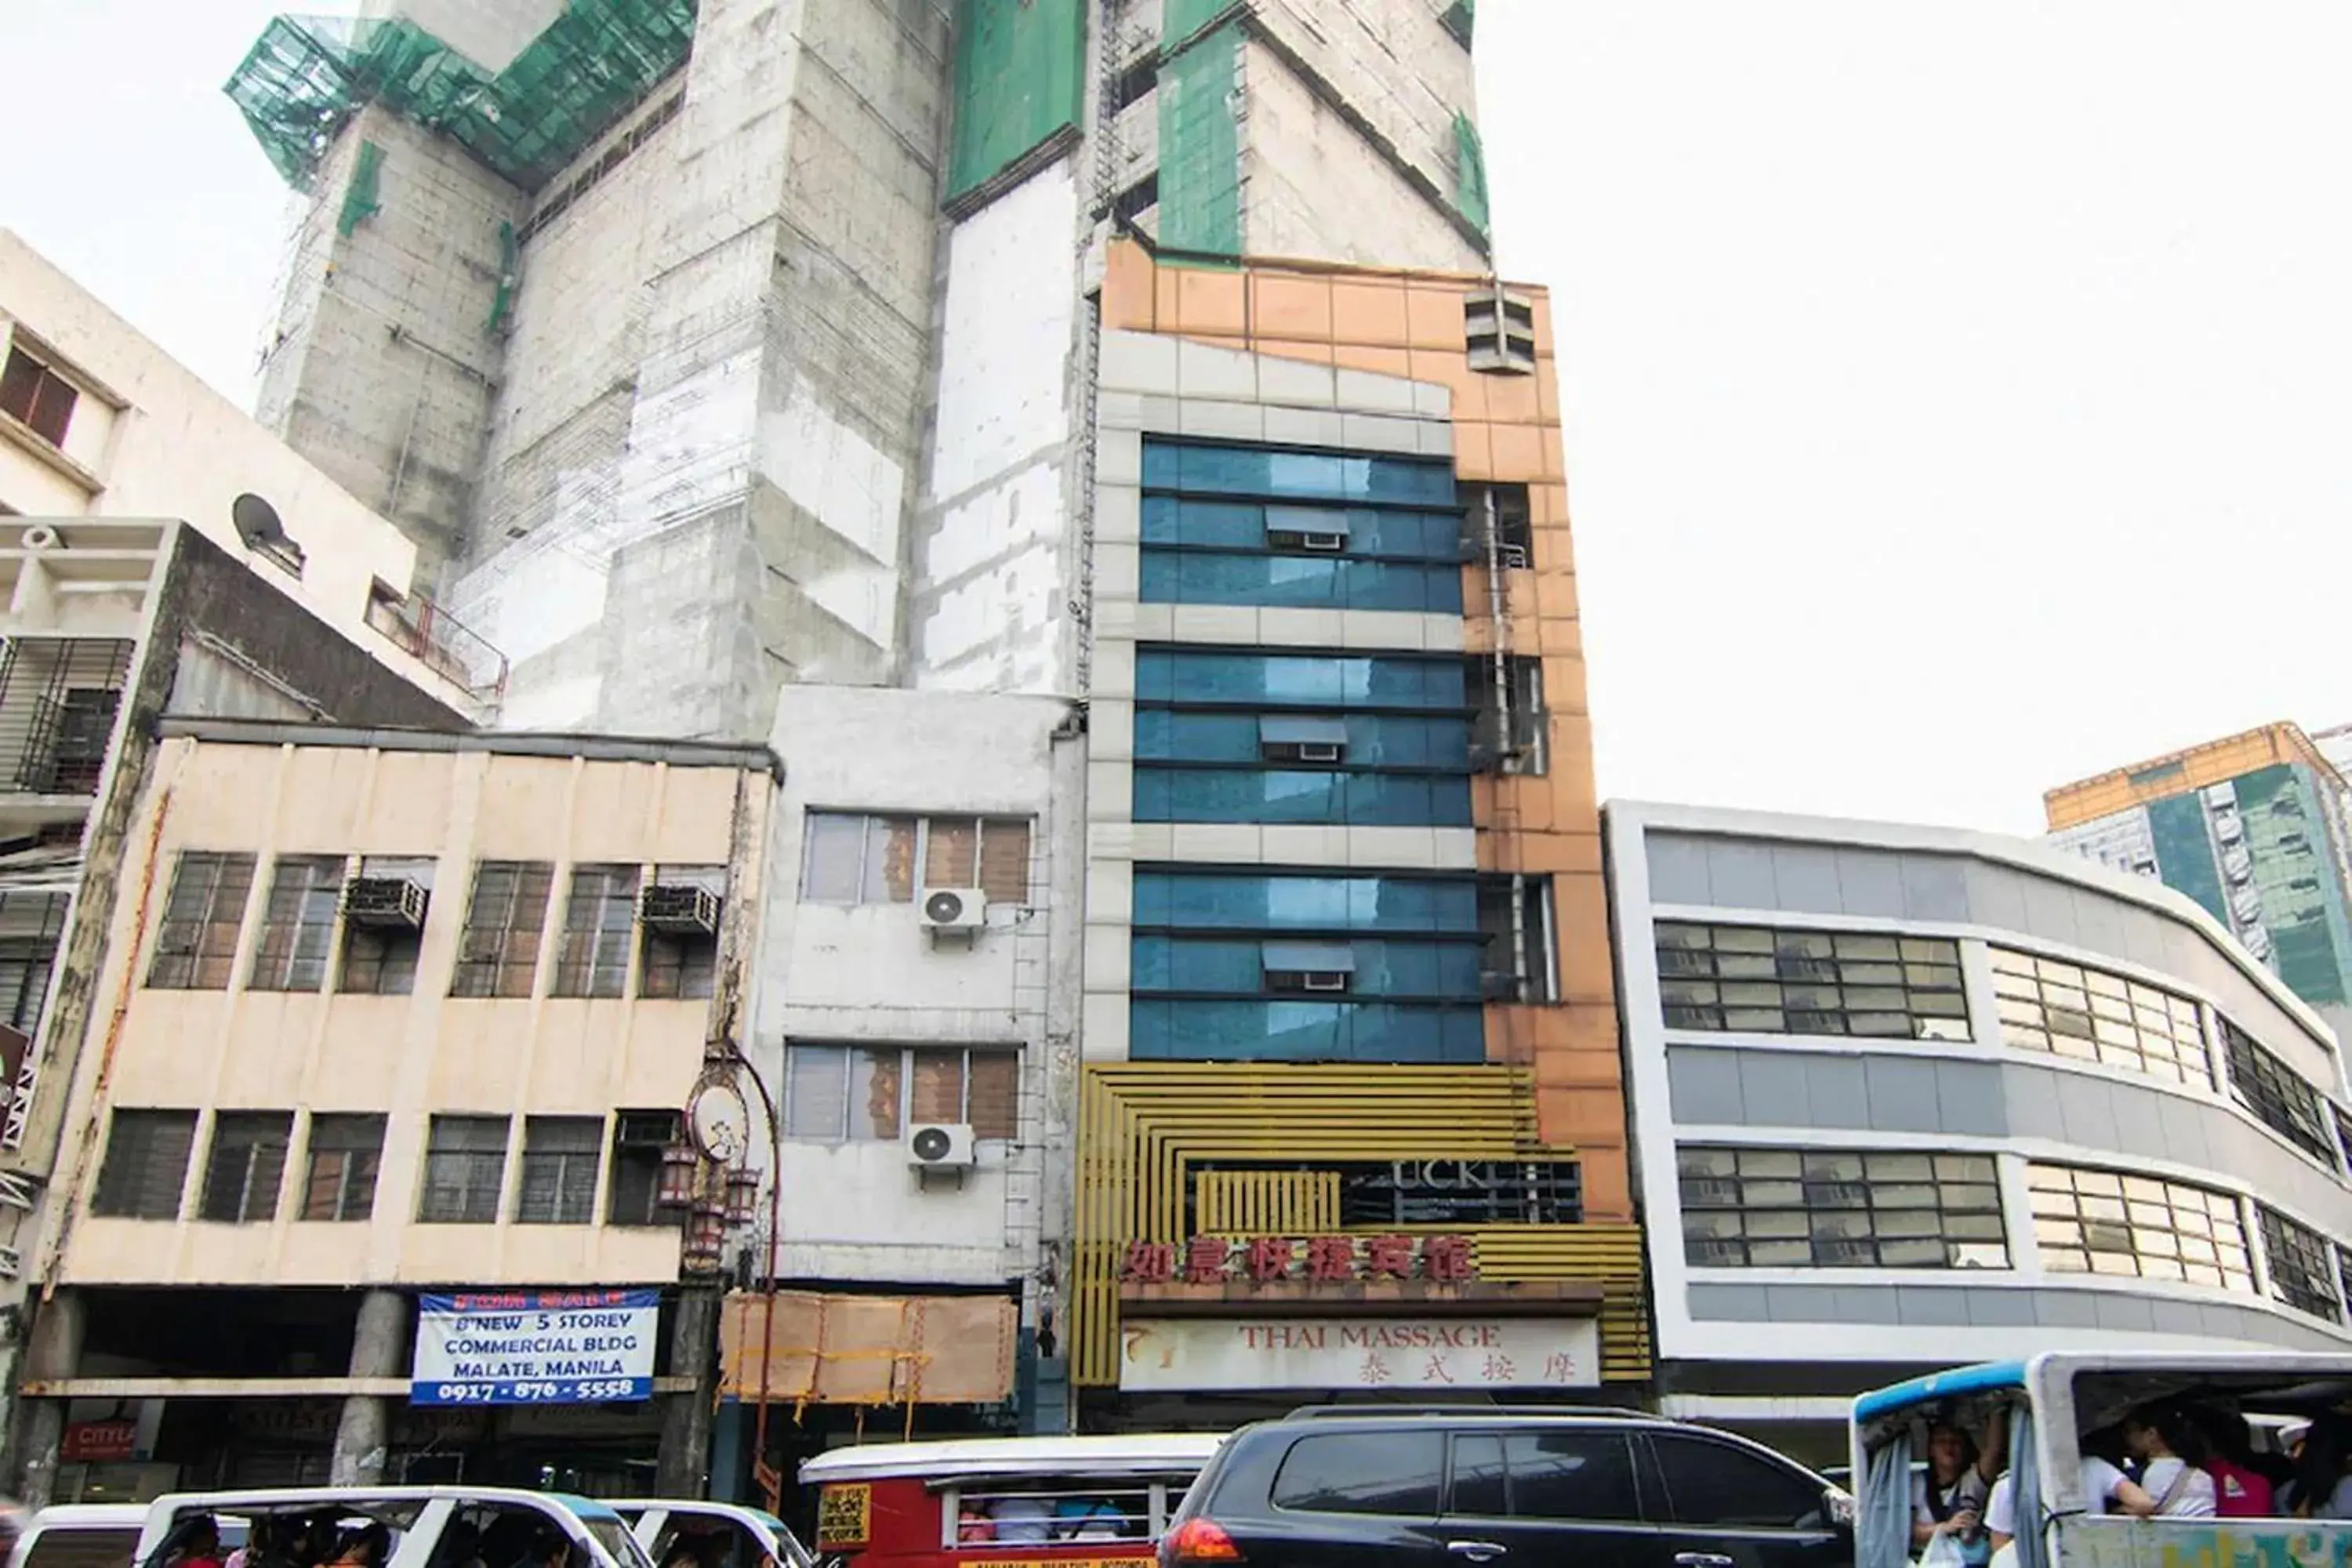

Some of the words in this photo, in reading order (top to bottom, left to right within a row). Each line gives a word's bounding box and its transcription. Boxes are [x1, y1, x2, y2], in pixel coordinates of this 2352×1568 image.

[537, 1314, 550, 1330] 5
[558, 1312, 633, 1329] STOREY
[445, 1337, 578, 1356] COMMERCIAL
[583, 1334, 637, 1352] BLDG
[1239, 1324, 1327, 1349] THAI
[1339, 1324, 1502, 1349] MASSAGE
[453, 1362, 539, 1378] MALATE,
[546, 1359, 624, 1376] MANILA
[438, 1383, 495, 1399] 0917
[514, 1381, 558, 1398] 876
[576, 1379, 634, 1399] 5558
